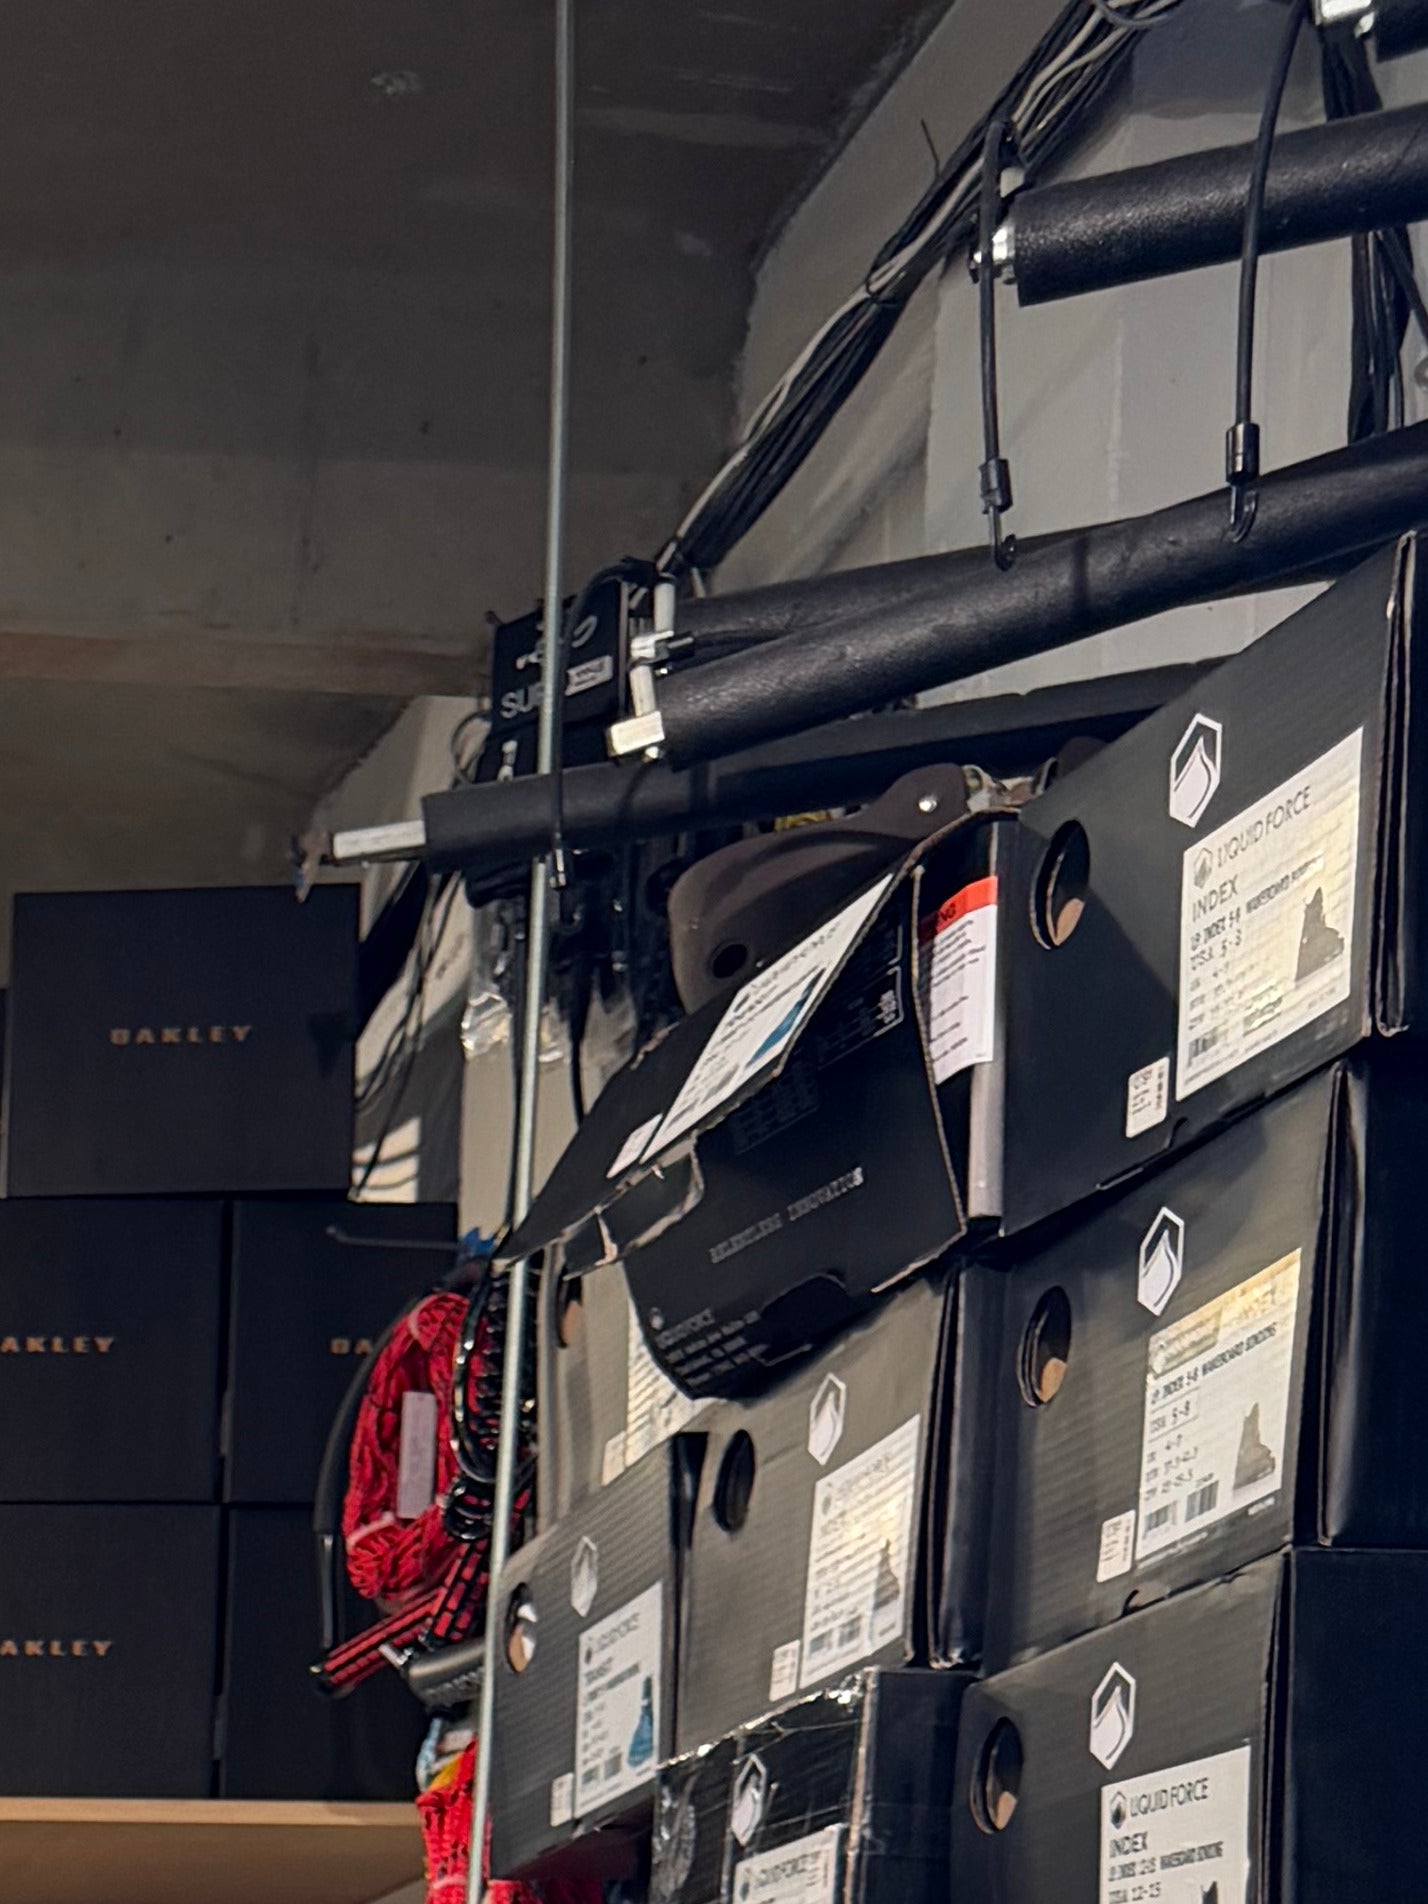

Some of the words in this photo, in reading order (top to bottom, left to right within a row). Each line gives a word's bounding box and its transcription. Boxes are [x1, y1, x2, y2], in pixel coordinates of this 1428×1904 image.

[1216, 815, 1264, 870] LIQUID
[1265, 783, 1311, 837] FORCE
[1191, 872, 1238, 923] INDEX
[110, 1025, 252, 1045] OAKLEY
[1129, 1786, 1168, 1818] LIQUID
[1170, 1775, 1209, 1809] FORCE
[1109, 1829, 1148, 1859] INDEX
